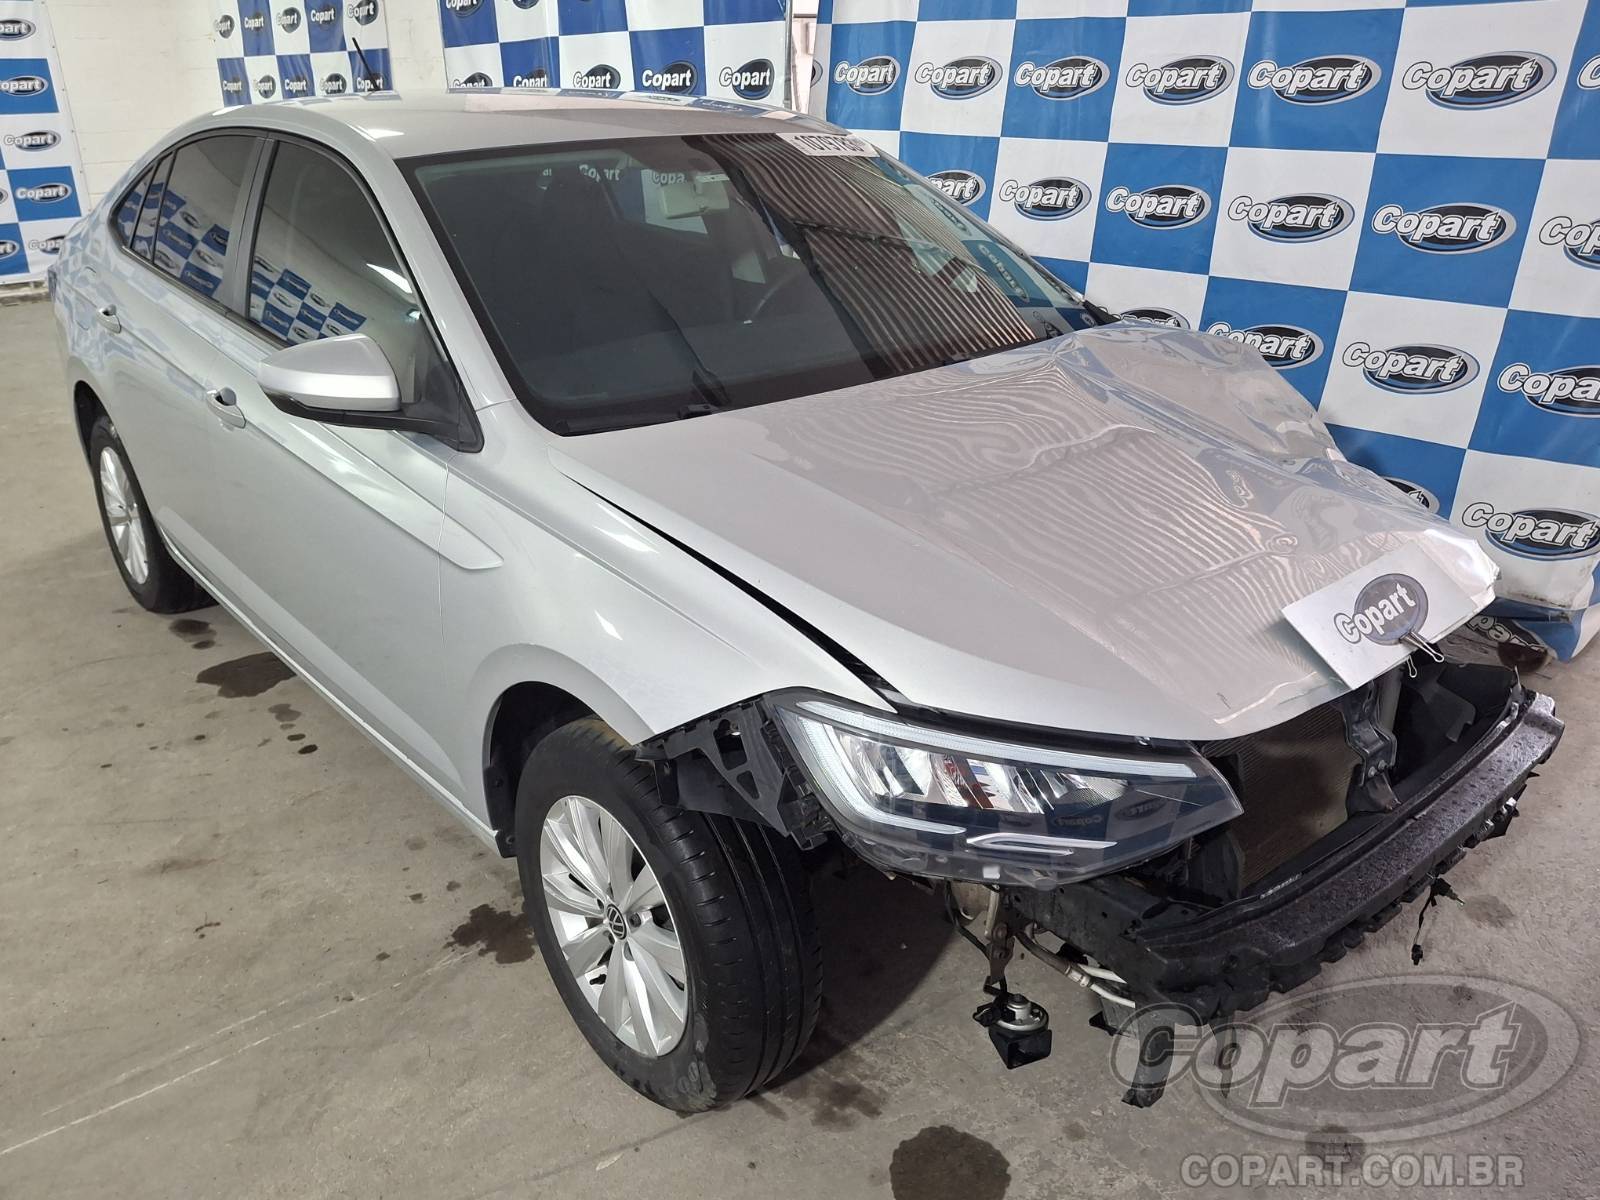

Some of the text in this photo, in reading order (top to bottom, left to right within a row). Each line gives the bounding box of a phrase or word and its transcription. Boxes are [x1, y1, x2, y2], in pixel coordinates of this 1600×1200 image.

[311, 8, 335, 24] Copart
[0, 79, 40, 93] opart
[284, 78, 307, 93] Copart
[574, 71, 611, 89] Copart
[642, 68, 692, 91] Copart
[719, 67, 770, 91] Copart
[834, 60, 895, 88] Copart
[915, 61, 992, 90] Copart
[1015, 61, 1097, 90] Copart
[1126, 61, 1224, 92] Copart
[1249, 60, 1368, 97] Copart
[1402, 59, 1537, 98] Copart
[4, 134, 54, 148] Copart
[16, 185, 66, 200] Copart
[999, 179, 1080, 208] Copart
[1107, 188, 1204, 220] Copart
[1228, 196, 1340, 231] Copart
[1372, 205, 1501, 242] Copart
[1342, 342, 1465, 383] Copart
[1497, 362, 1600, 405] Copa
[1462, 502, 1600, 550] Copart
[1333, 582, 1417, 644] Copart
